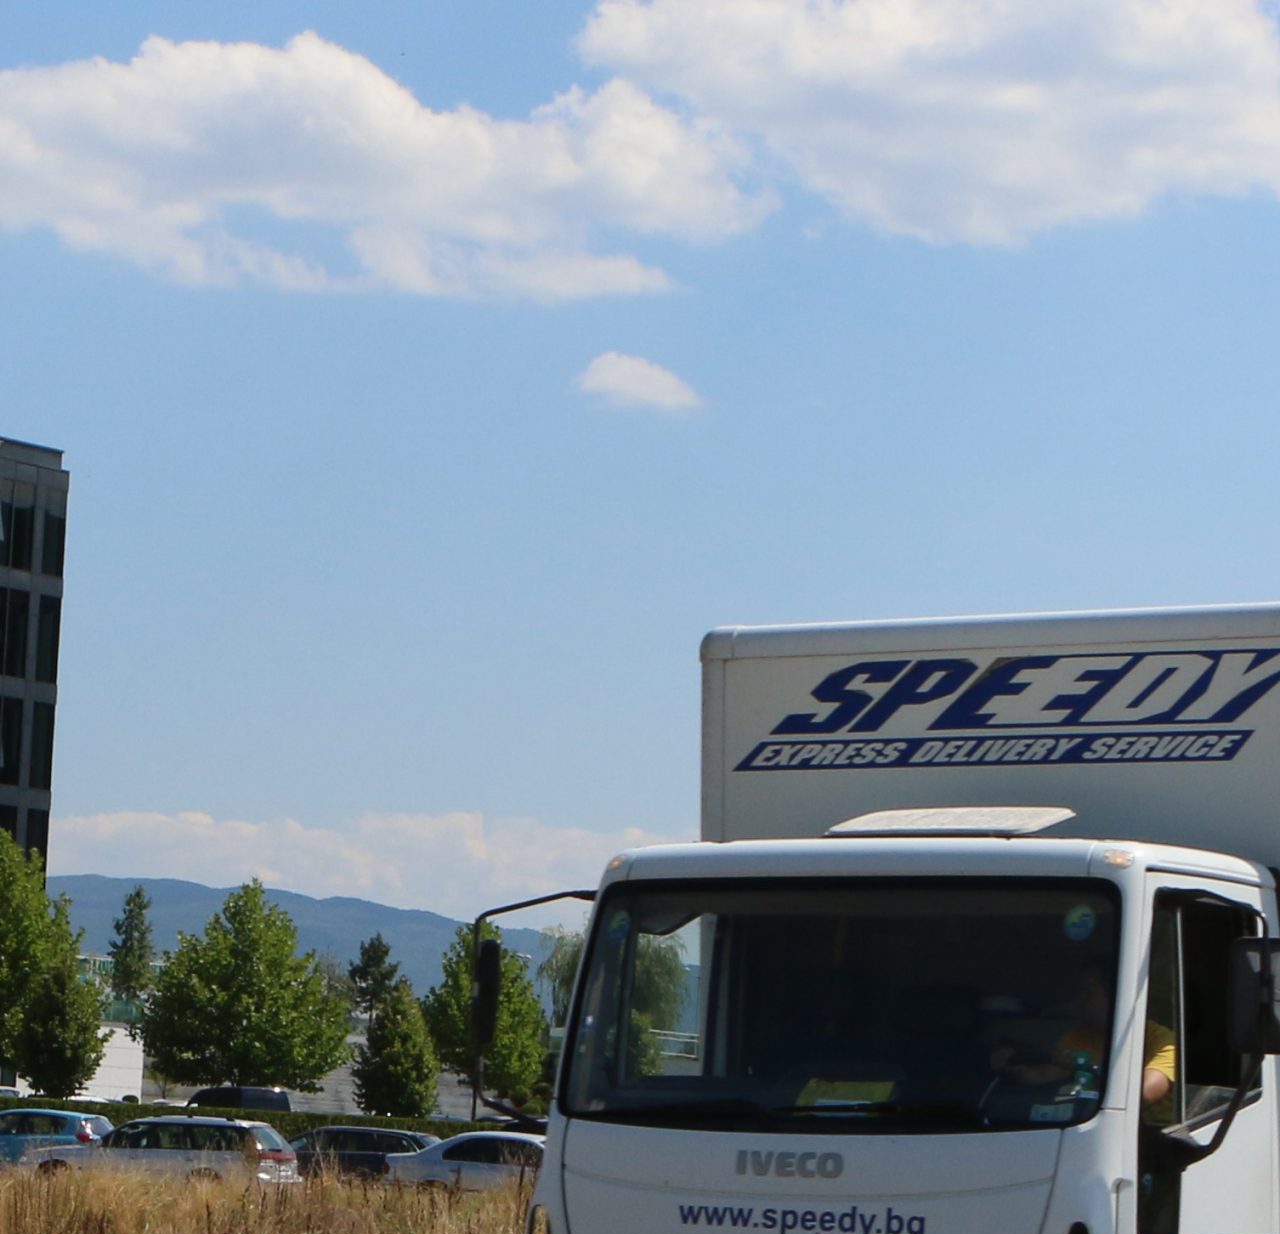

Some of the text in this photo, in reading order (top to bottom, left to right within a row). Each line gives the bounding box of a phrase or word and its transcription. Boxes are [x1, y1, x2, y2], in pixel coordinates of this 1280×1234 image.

[751, 733, 1243, 768] EXPRESS DELIVERY SERVICE
[735, 1149, 844, 1179] IVECO
